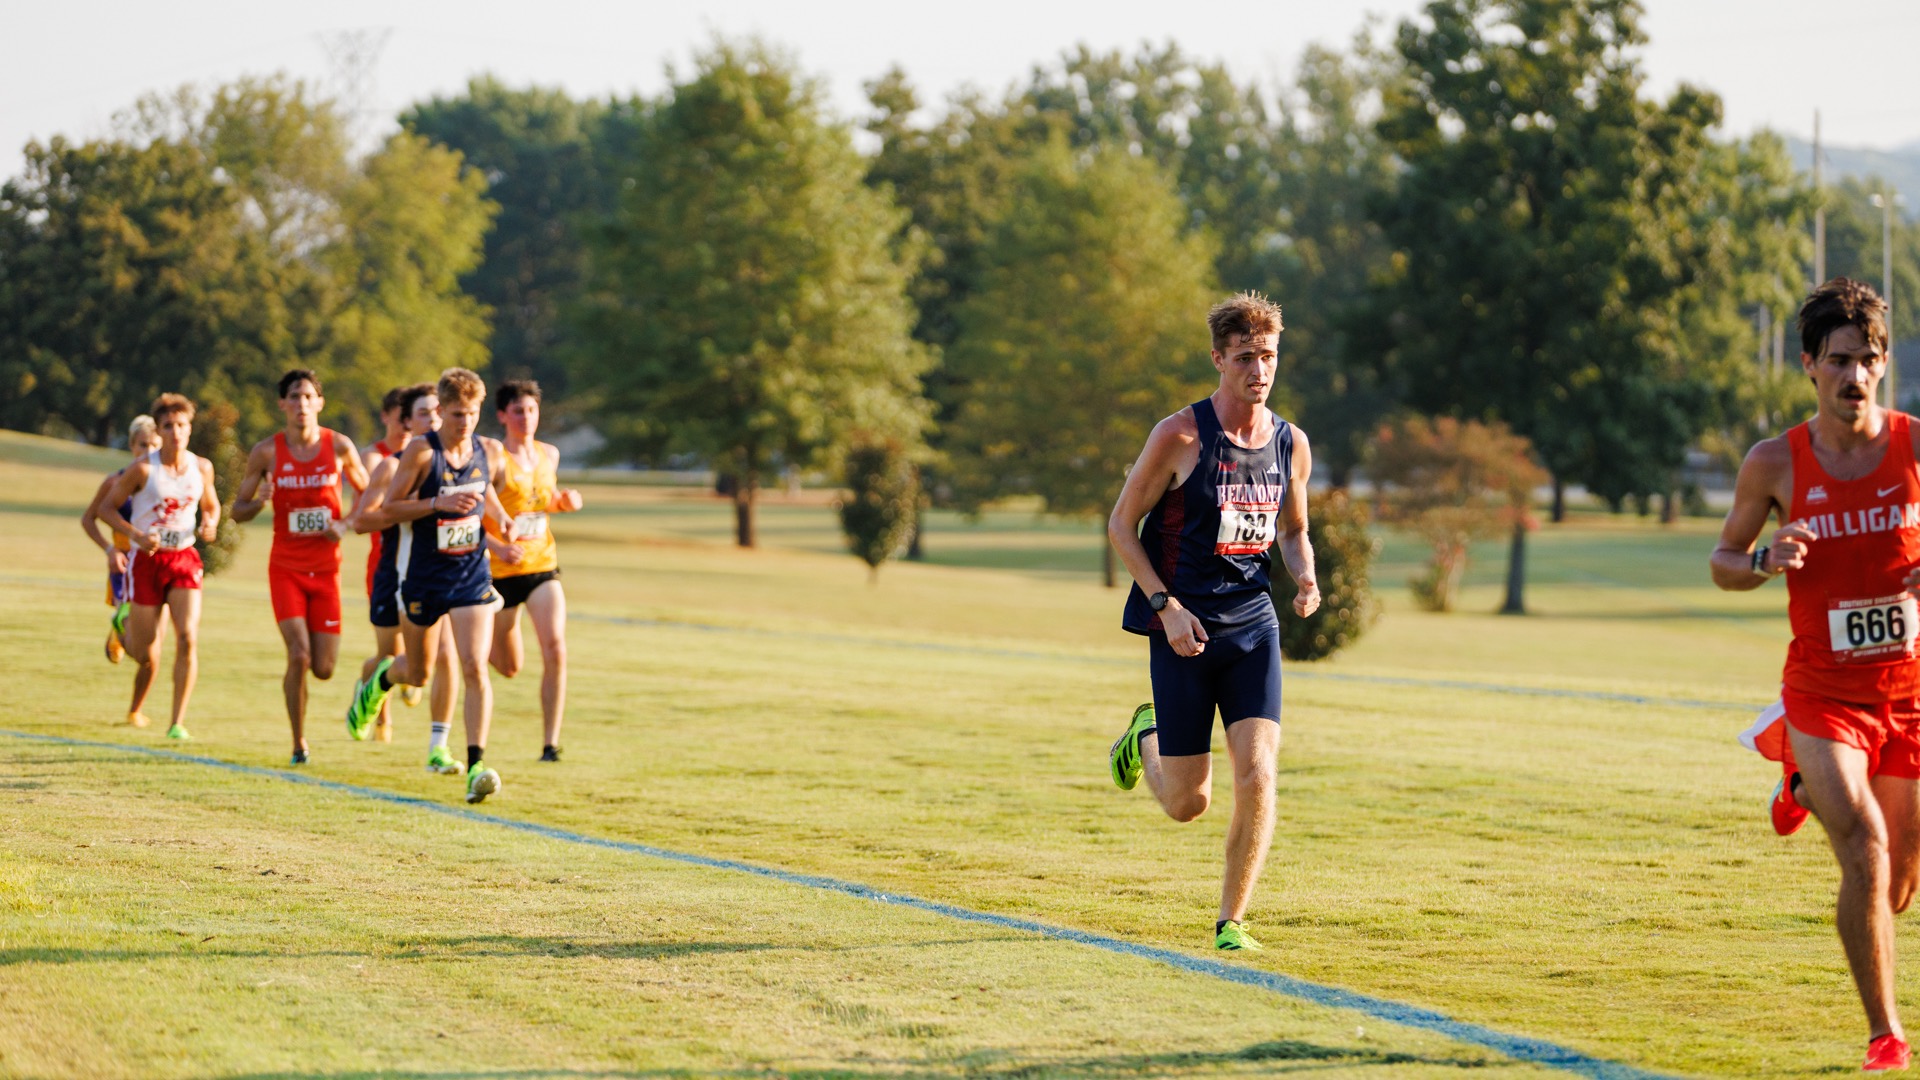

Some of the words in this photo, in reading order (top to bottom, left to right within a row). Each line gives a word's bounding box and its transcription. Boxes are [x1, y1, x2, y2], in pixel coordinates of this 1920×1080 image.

[1216, 484, 1282, 507] BELMONT
[297, 512, 324, 532] 669
[1800, 502, 1920, 539] MILLIGAN
[447, 526, 473, 547] 226
[1846, 605, 1905, 646] 666
